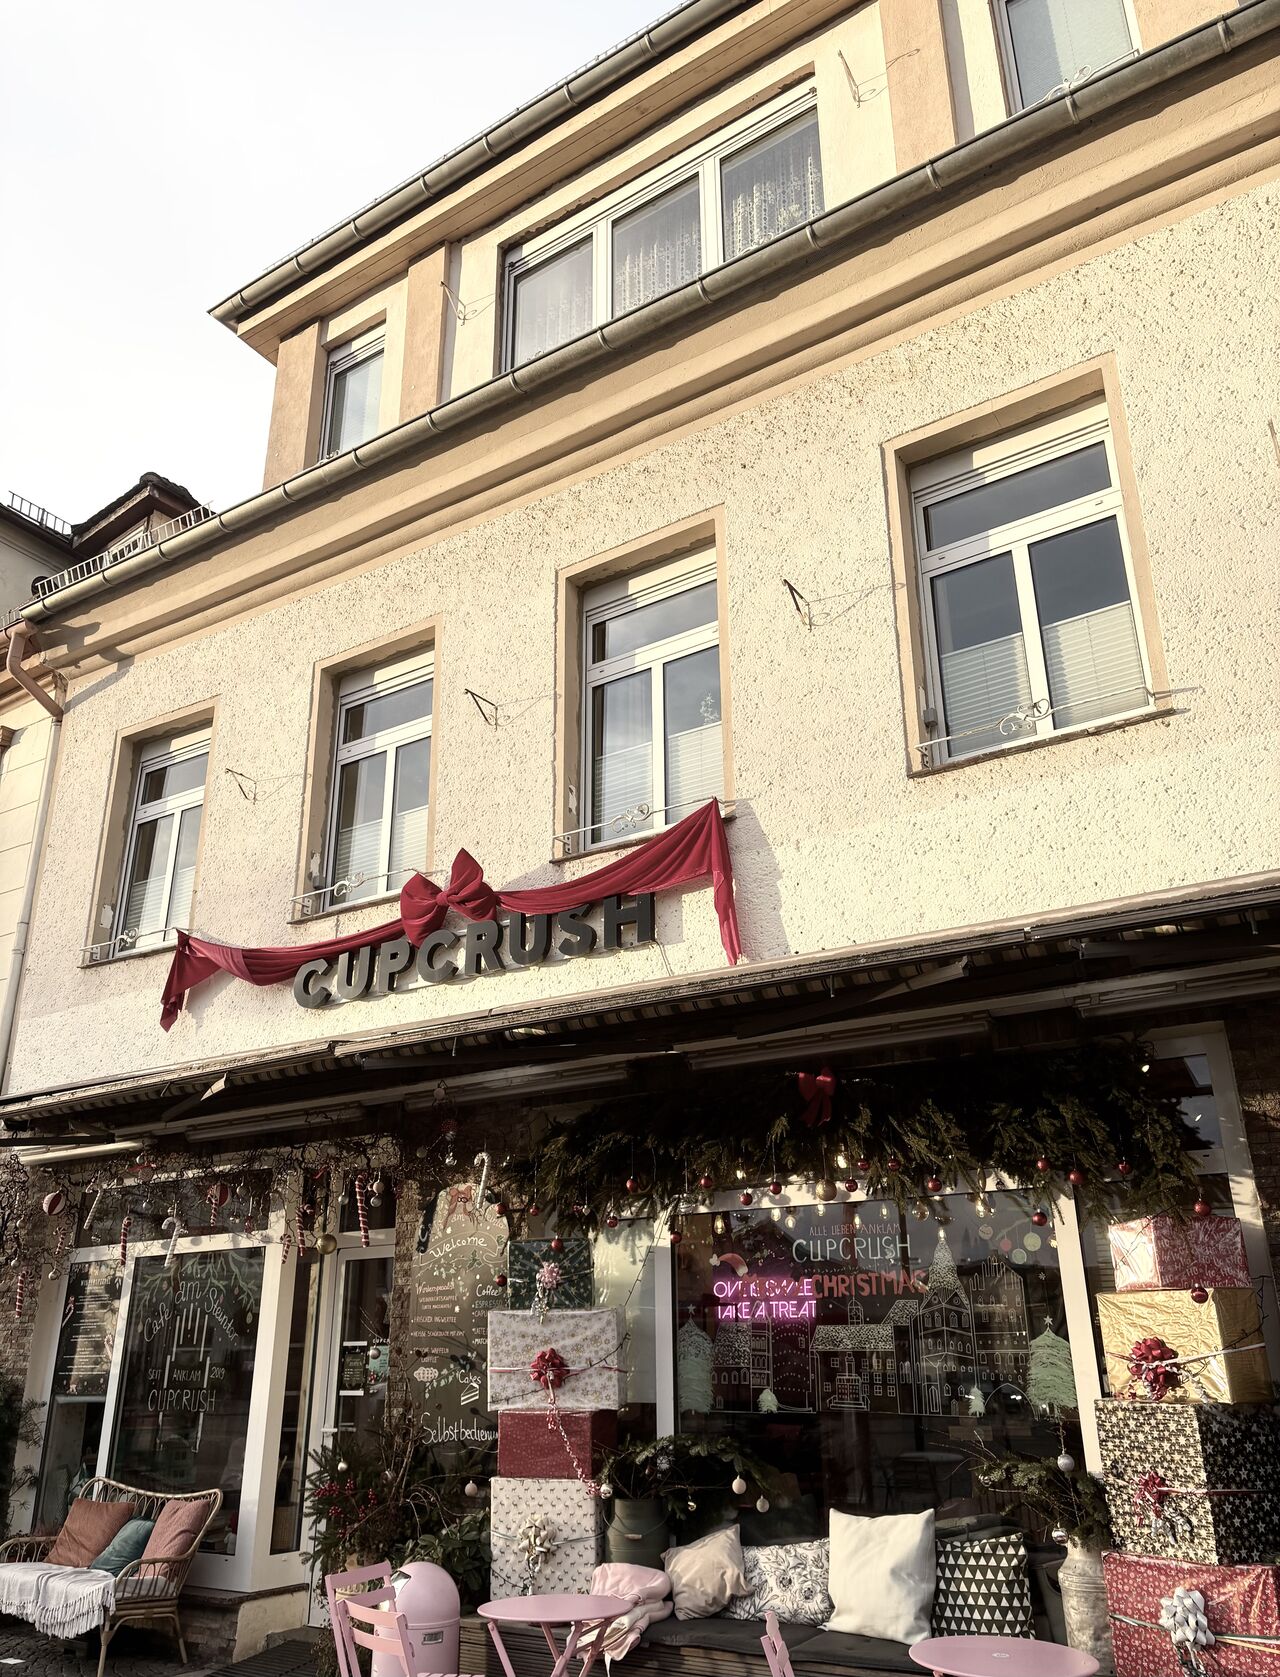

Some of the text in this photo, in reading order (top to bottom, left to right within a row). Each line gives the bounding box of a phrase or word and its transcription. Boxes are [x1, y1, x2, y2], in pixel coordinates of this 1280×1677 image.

[293, 893, 655, 1009] CUPCRUSH
[809, 1226, 828, 1237] ALLE
[861, 1222, 902, 1235] ANKLAM
[430, 1236, 488, 1258] Welcome
[792, 1234, 911, 1263] CUPCRUSH
[476, 1283, 500, 1297] Coffee
[175, 1280, 202, 1304] am
[204, 1287, 239, 1342] Steintor
[754, 1300, 766, 1319] A
[769, 1300, 817, 1319] TREAT
[148, 1366, 226, 1382] SEIT ANKLAM 2019
[458, 1369, 482, 1384] Cakes
[148, 1388, 217, 1412] CUPCRUSH
